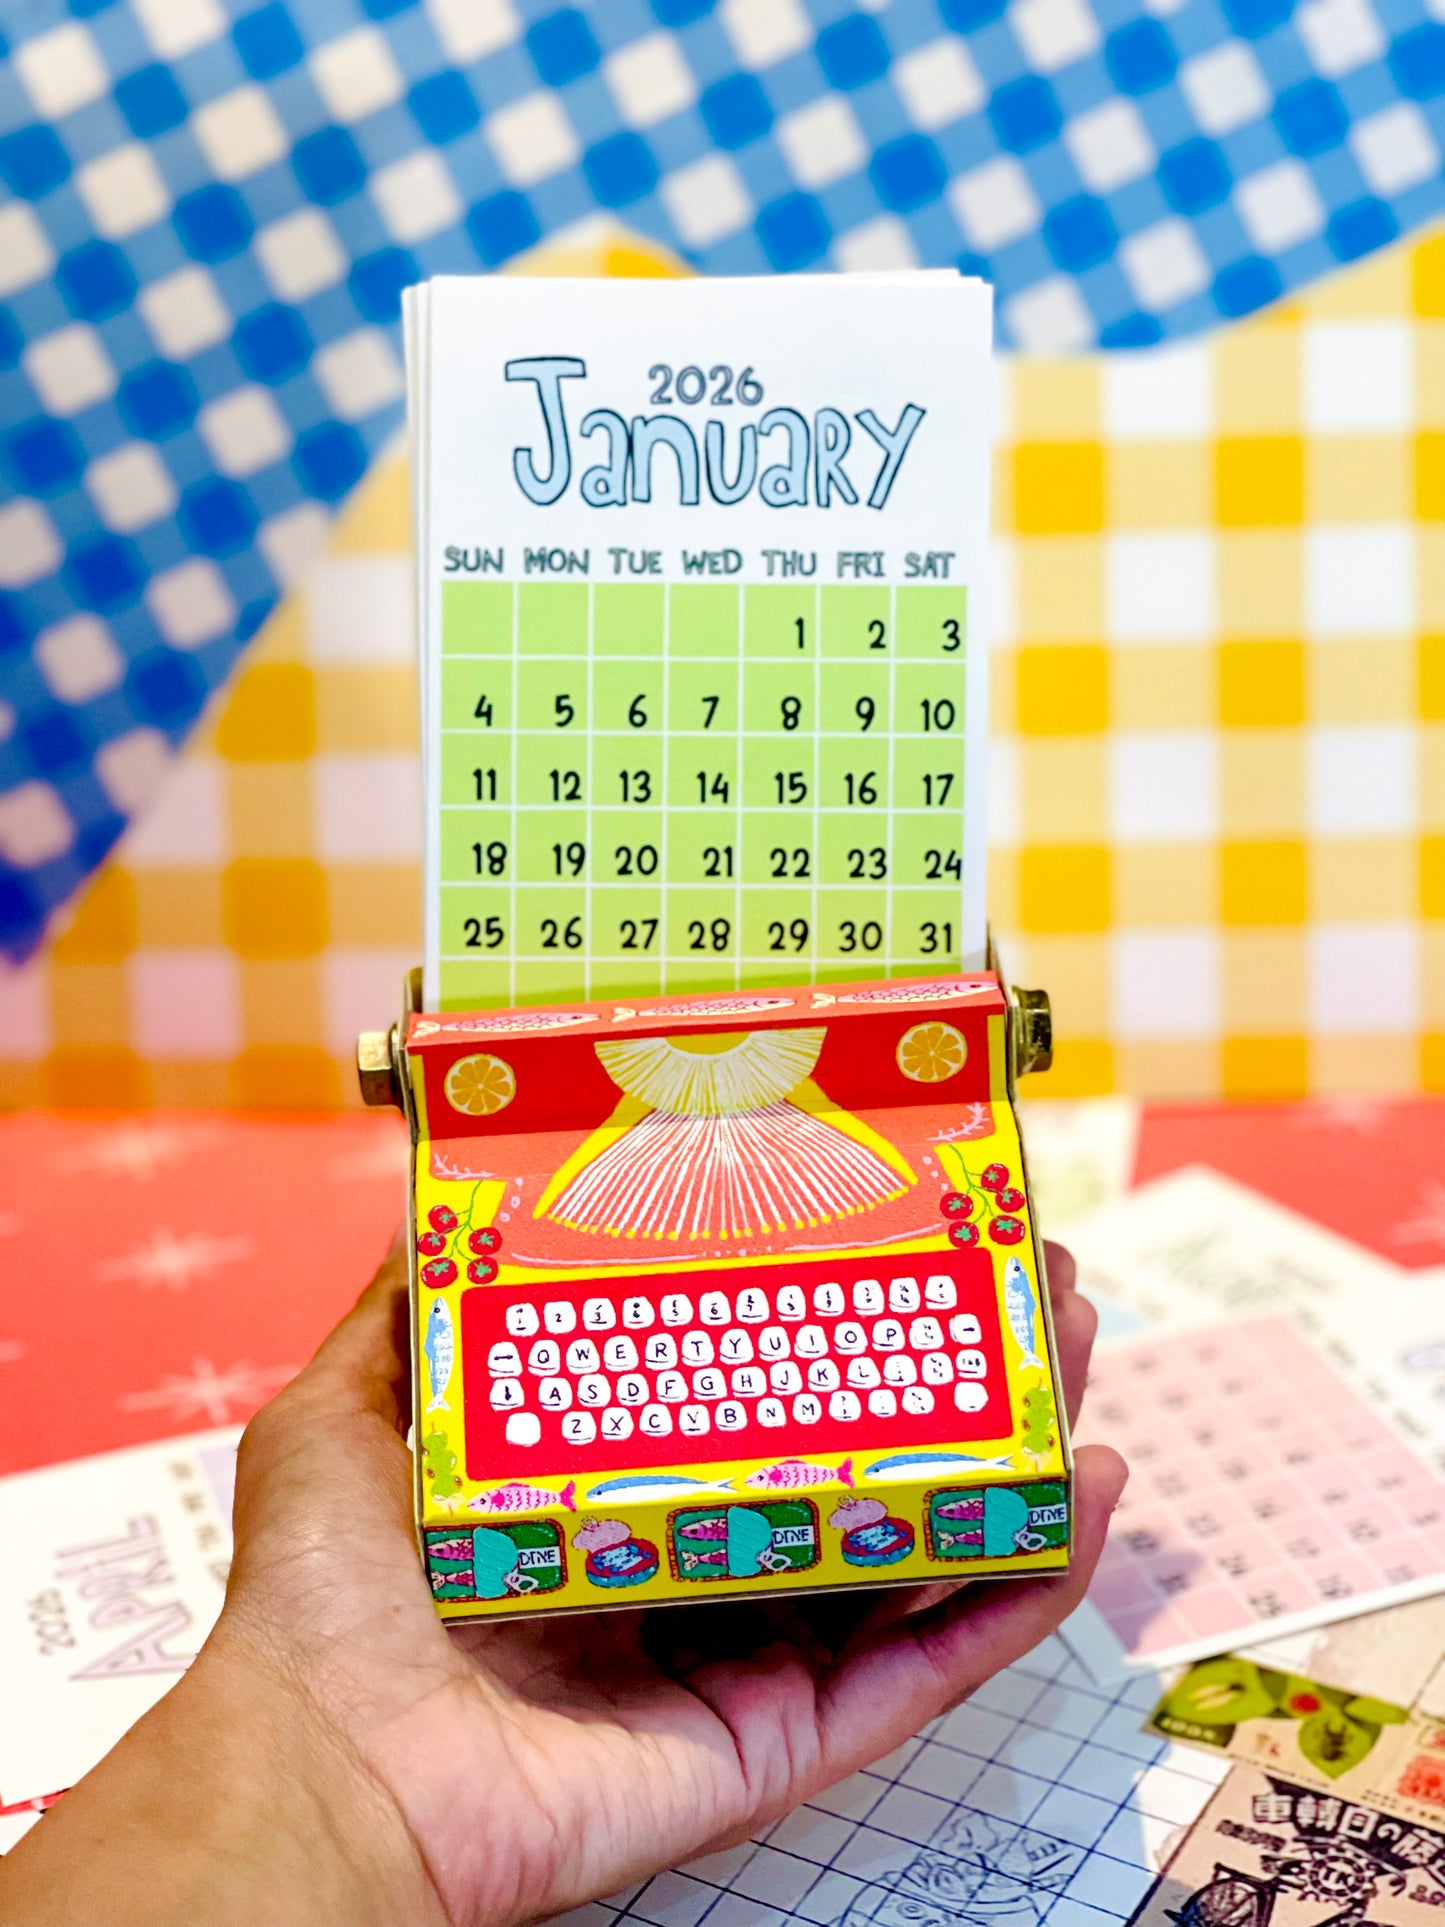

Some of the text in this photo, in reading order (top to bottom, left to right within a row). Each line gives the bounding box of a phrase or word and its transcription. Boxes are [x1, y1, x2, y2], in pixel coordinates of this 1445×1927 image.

[648, 364, 764, 405] 2026
[444, 545, 955, 579] SUN MON TUE WED THU FRI SAT
[796, 618, 960, 651] 1 2 3
[474, 694, 955, 731] 4 5 6 7 8 9 10
[473, 769, 954, 805] 11 12 13 14 15 16 17
[473, 842, 961, 880] 18 19 20 21 22 23 24
[464, 917, 952, 953] 25 26 27 28 29 30 31
[537, 1328, 897, 1364] Q W E R T Y U I O P
[549, 1365, 870, 1401] A S D F G H J K L
[608, 1416, 624, 1432] X
[648, 1413, 660, 1429] C
[687, 1411, 699, 1424] V
[724, 1408, 737, 1424] B
[766, 1407, 776, 1418] N
[801, 1403, 815, 1416] M
